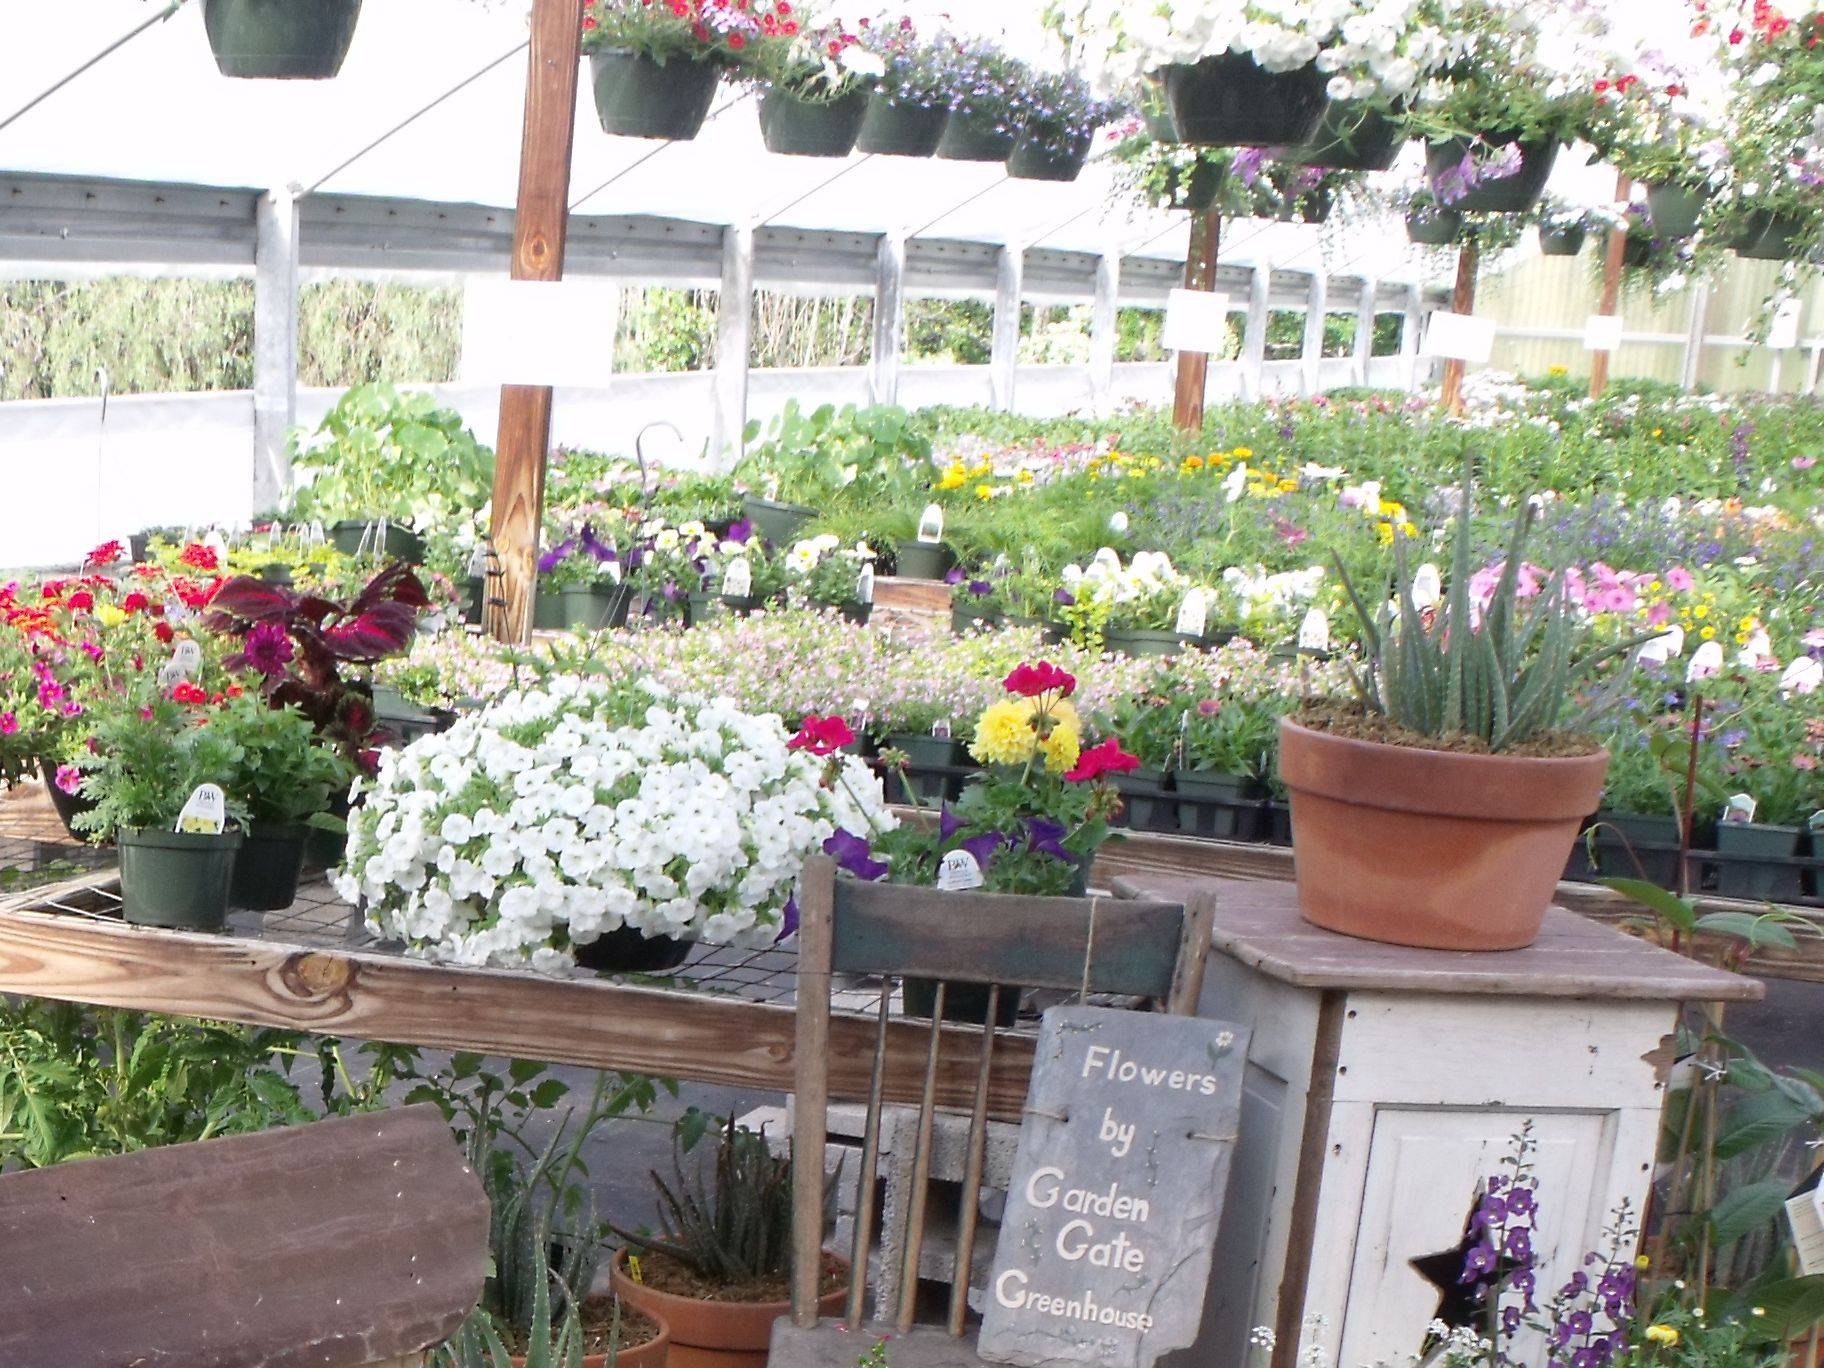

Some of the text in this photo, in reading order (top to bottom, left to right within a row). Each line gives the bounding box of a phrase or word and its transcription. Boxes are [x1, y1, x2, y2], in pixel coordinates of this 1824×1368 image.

[1082, 1045, 1217, 1095] Flowers
[1098, 1107, 1135, 1157] by
[1025, 1166, 1150, 1222] Garden
[1056, 1218, 1145, 1272] Gate
[995, 1268, 1154, 1333] Greenhouse
